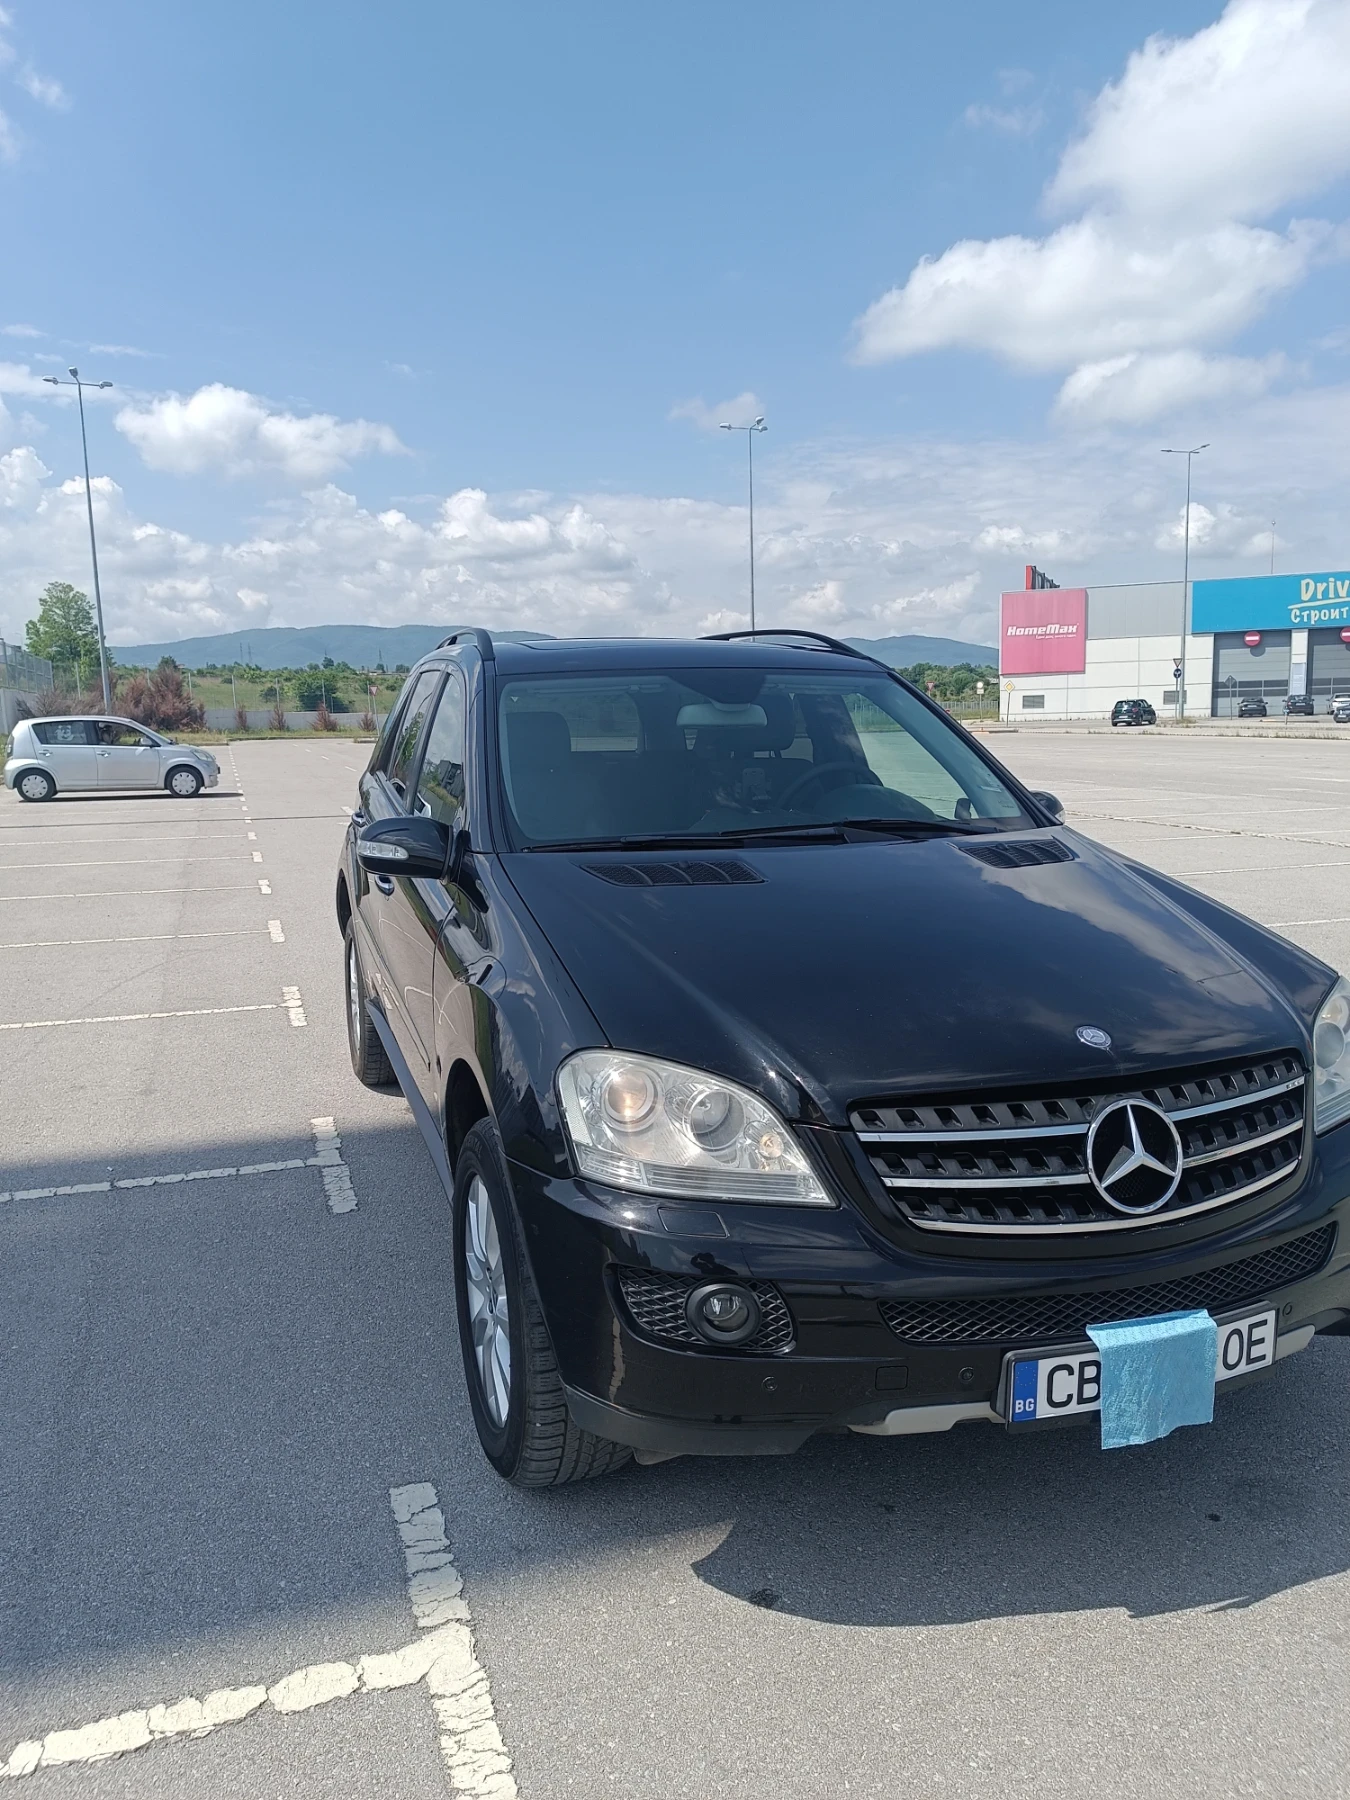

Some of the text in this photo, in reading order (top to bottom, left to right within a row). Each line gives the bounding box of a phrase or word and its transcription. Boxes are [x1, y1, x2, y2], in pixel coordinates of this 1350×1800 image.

[1300, 577, 1350, 601] Driv
[1291, 606, 1349, 625] Строит
[1006, 623, 1077, 636] HomeMax
[1015, 1398, 1034, 1413] BG
